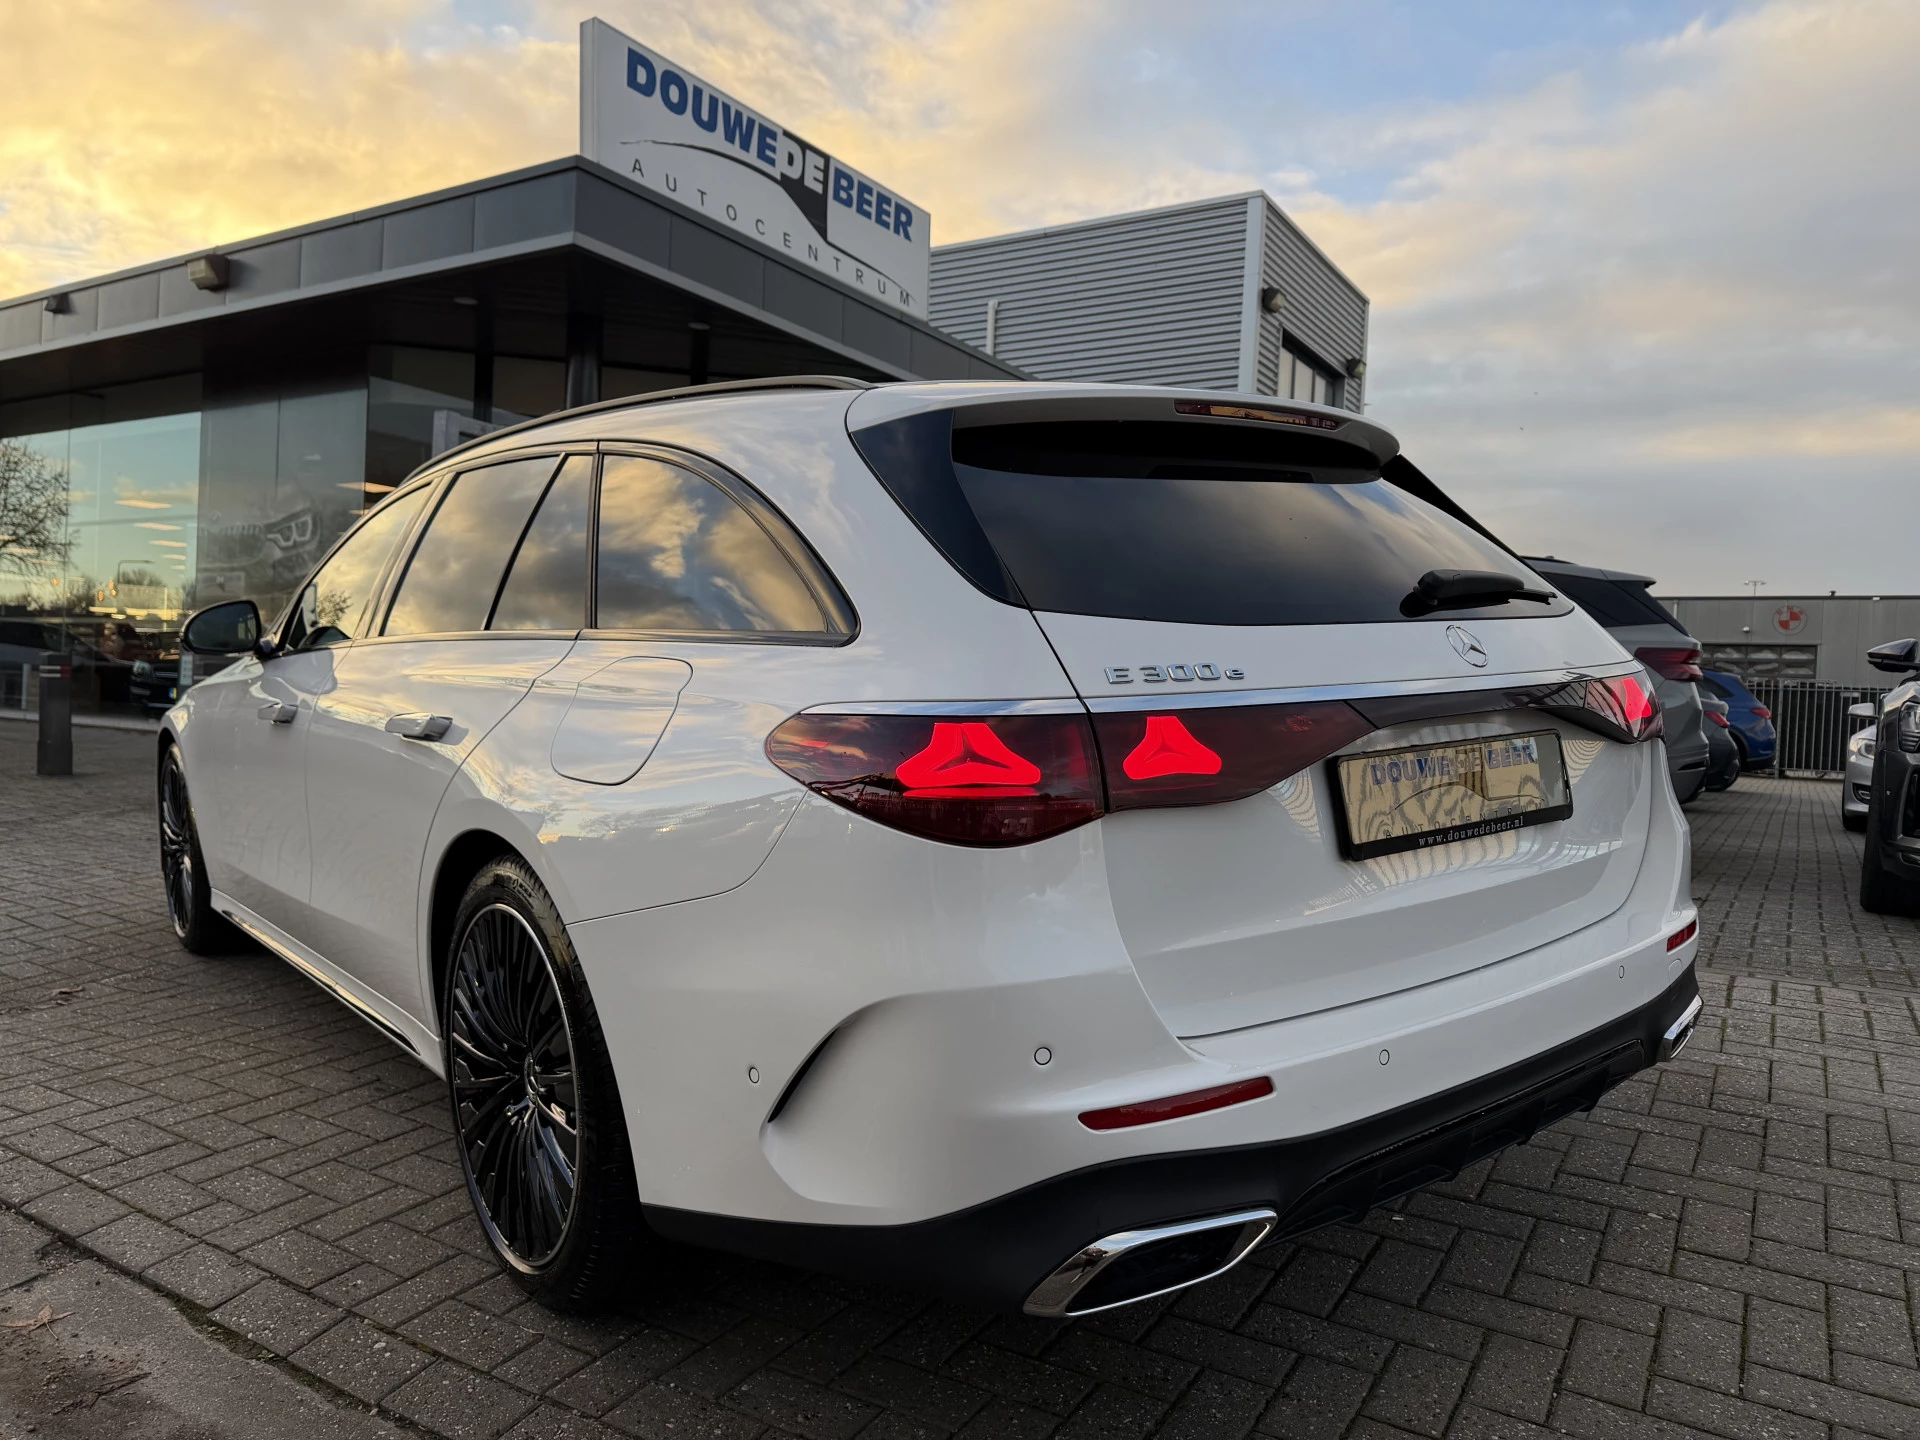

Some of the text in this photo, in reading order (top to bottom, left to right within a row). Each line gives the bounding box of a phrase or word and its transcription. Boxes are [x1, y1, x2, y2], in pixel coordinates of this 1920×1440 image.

[627, 46, 914, 242] DOUWE DE BEER
[631, 158, 910, 307] AUTOCENTRUM
[1104, 666, 1134, 684] E
[1370, 756, 1450, 786] DOUWE
[1487, 744, 1535, 770] BEER
[1418, 815, 1524, 847] www.douwedebeer.nl
